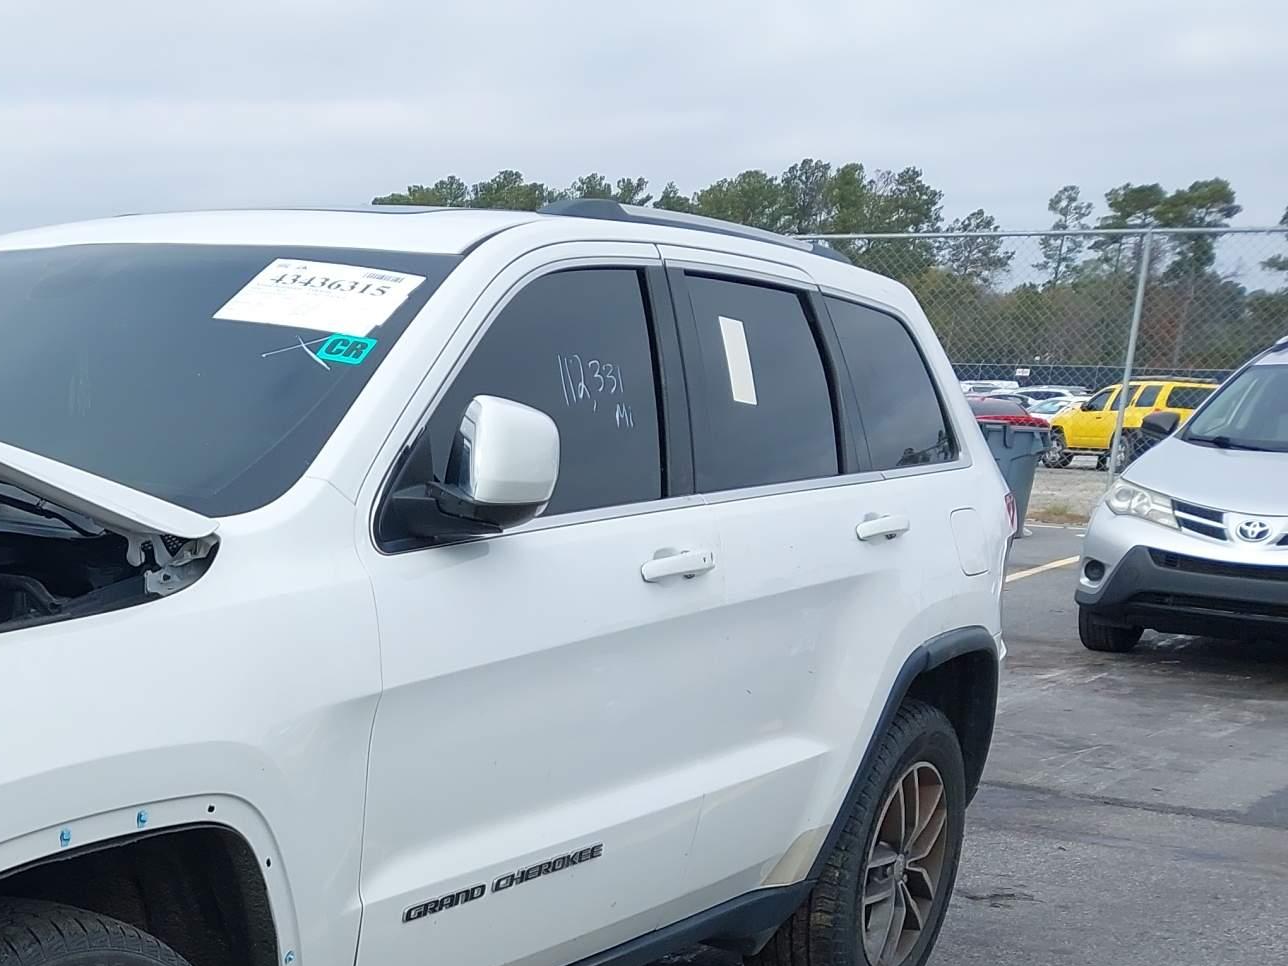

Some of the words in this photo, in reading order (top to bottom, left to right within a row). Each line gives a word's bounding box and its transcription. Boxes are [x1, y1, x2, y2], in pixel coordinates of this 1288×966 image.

[270, 273, 391, 297] 43436315
[324, 337, 369, 359] CR
[402, 883, 487, 924] GRAND
[491, 842, 604, 893] CHEROKEE
